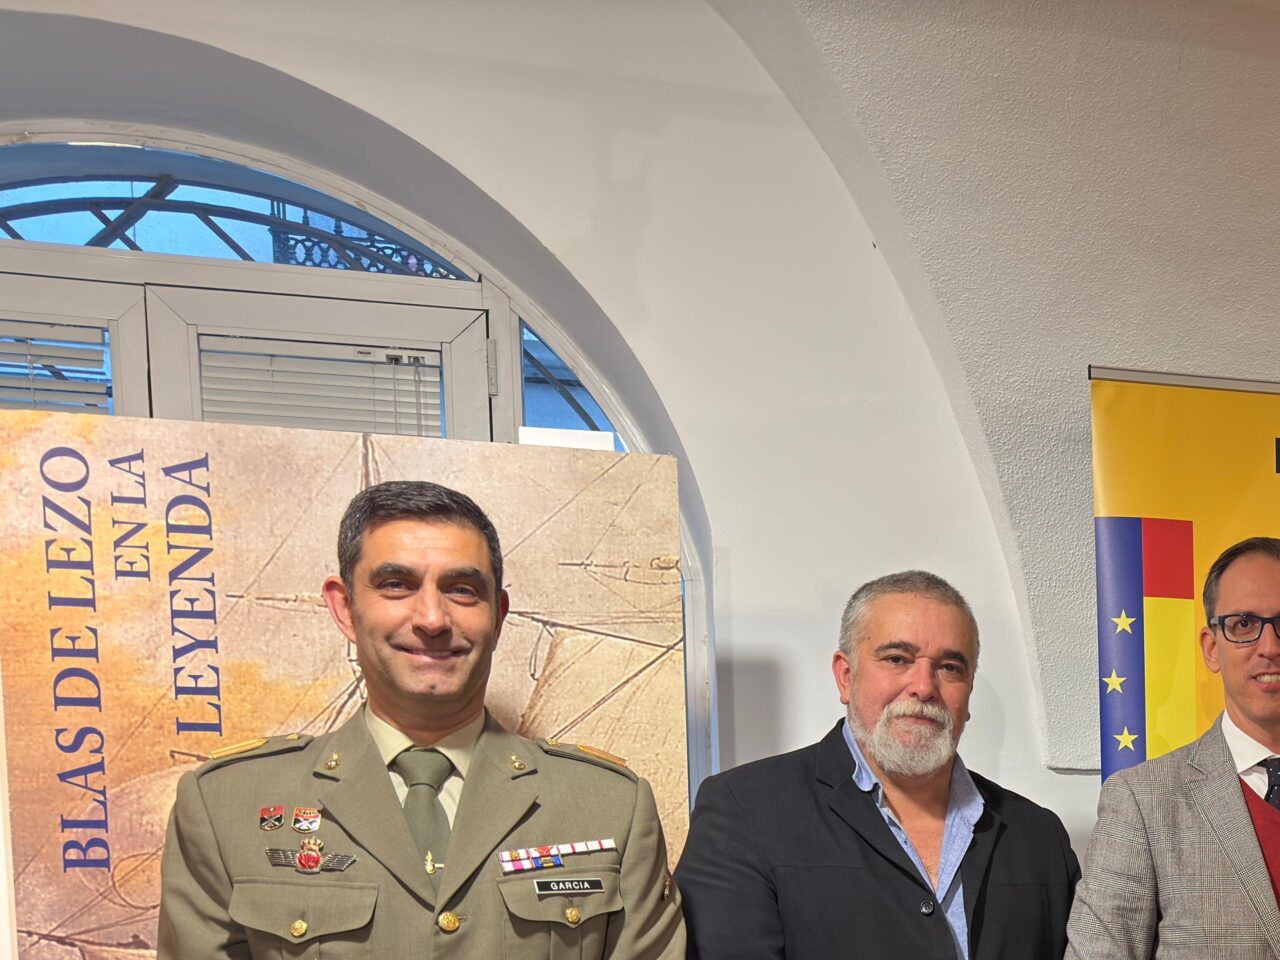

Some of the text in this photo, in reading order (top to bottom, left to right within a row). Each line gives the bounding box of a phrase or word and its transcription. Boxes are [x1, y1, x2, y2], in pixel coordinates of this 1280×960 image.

[107, 448, 151, 582] EN LA
[161, 452, 223, 736] LEYENDA
[39, 446, 112, 873] BLAS DE LEZO
[550, 881, 591, 891] GARCIA
